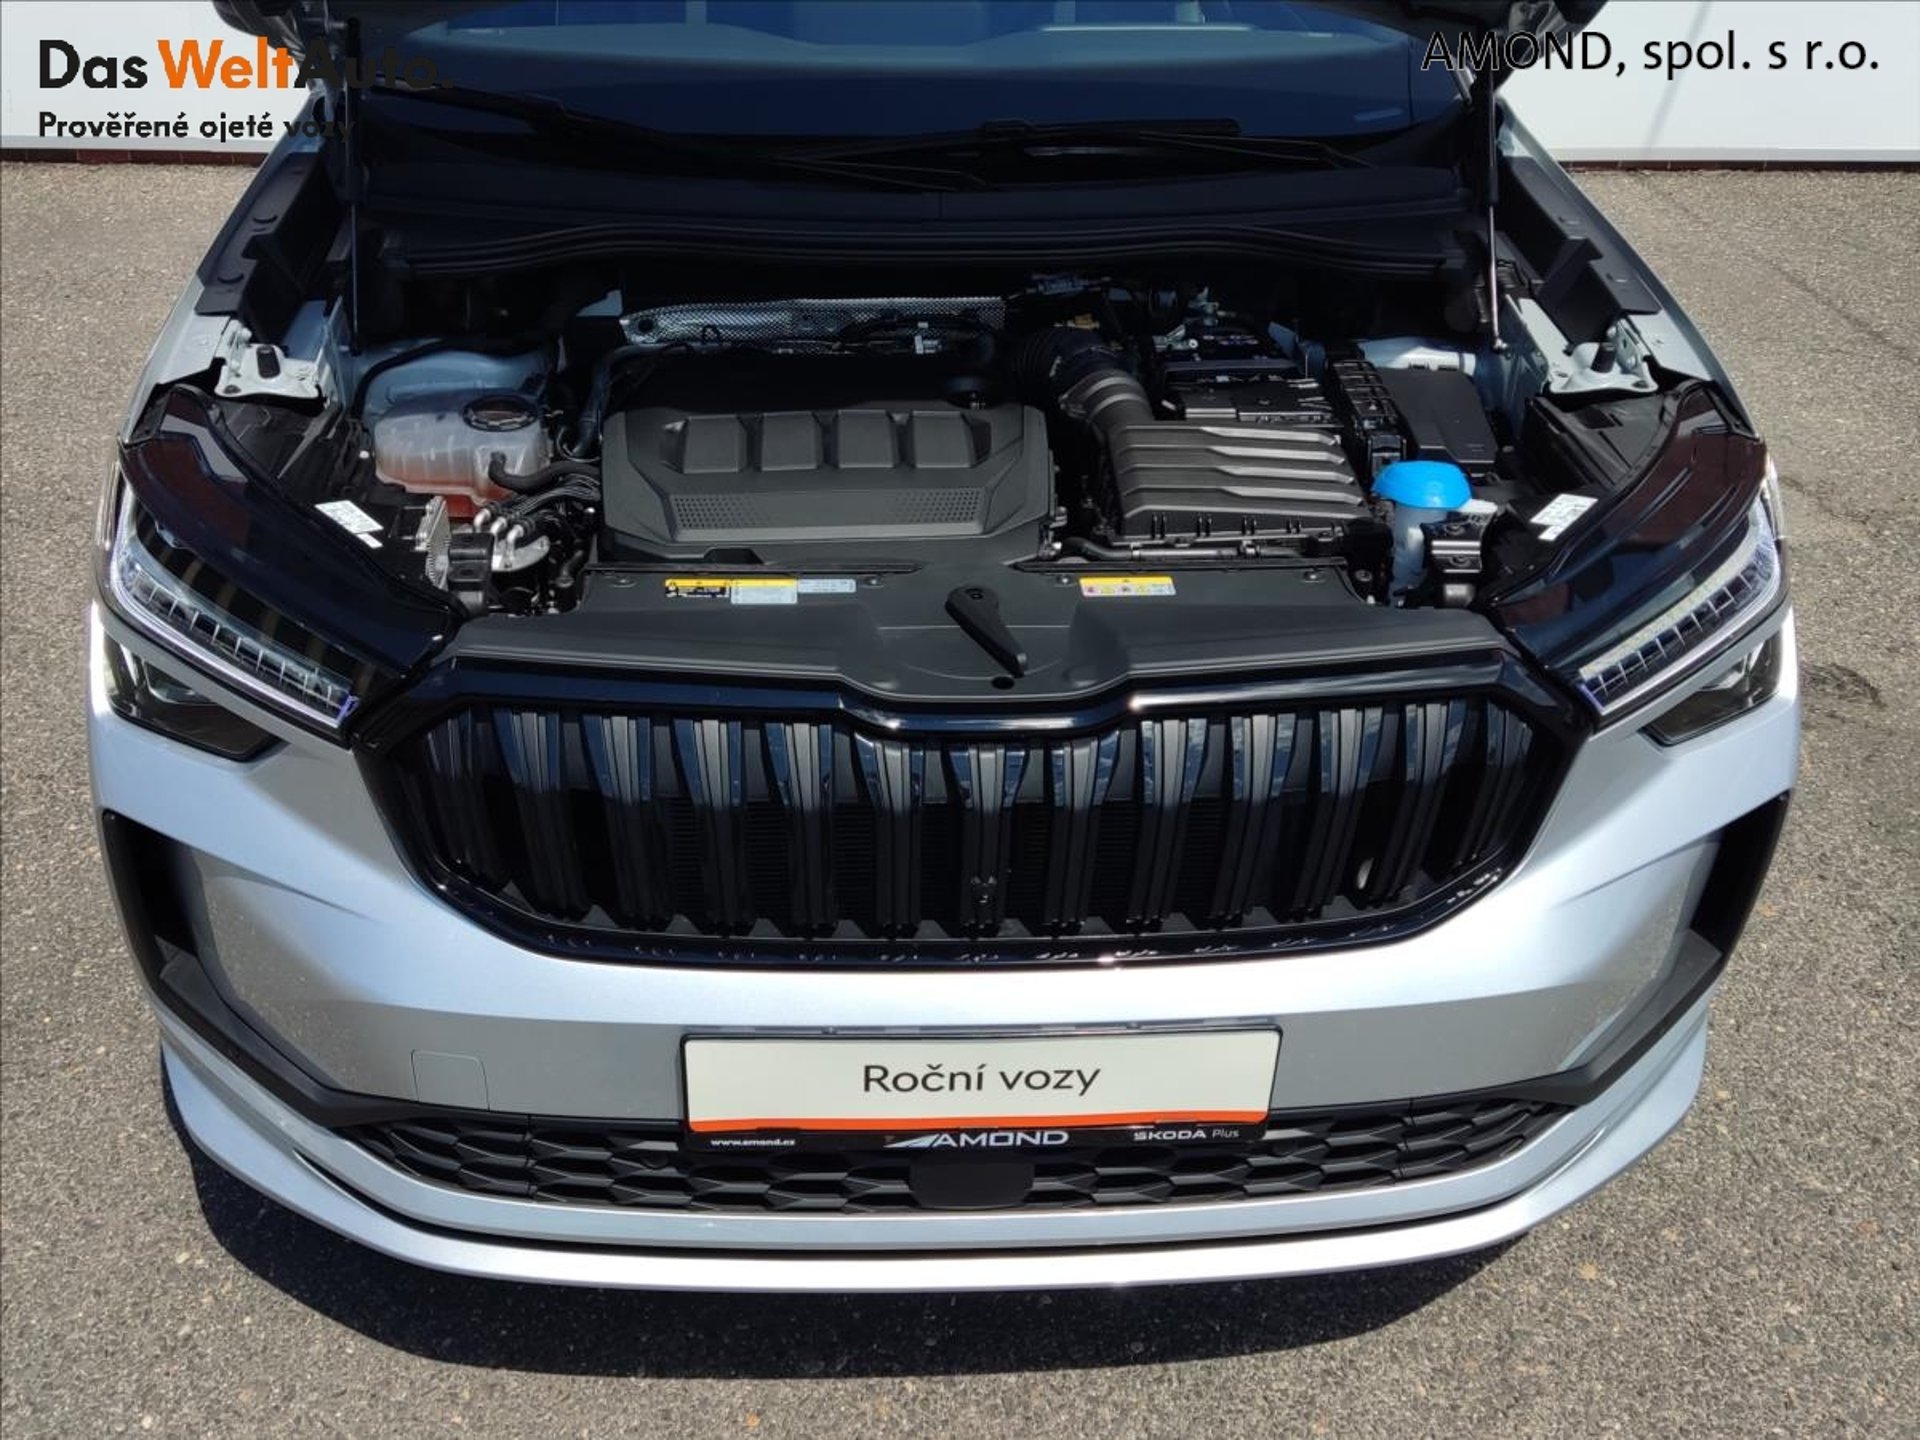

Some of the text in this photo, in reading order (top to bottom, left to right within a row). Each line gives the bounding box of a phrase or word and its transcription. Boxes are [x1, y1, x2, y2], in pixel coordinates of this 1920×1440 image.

[863, 1064, 1101, 1096] Roční vozy
[932, 1130, 1070, 1148] AMOND
[1211, 1128, 1240, 1139] Plus
